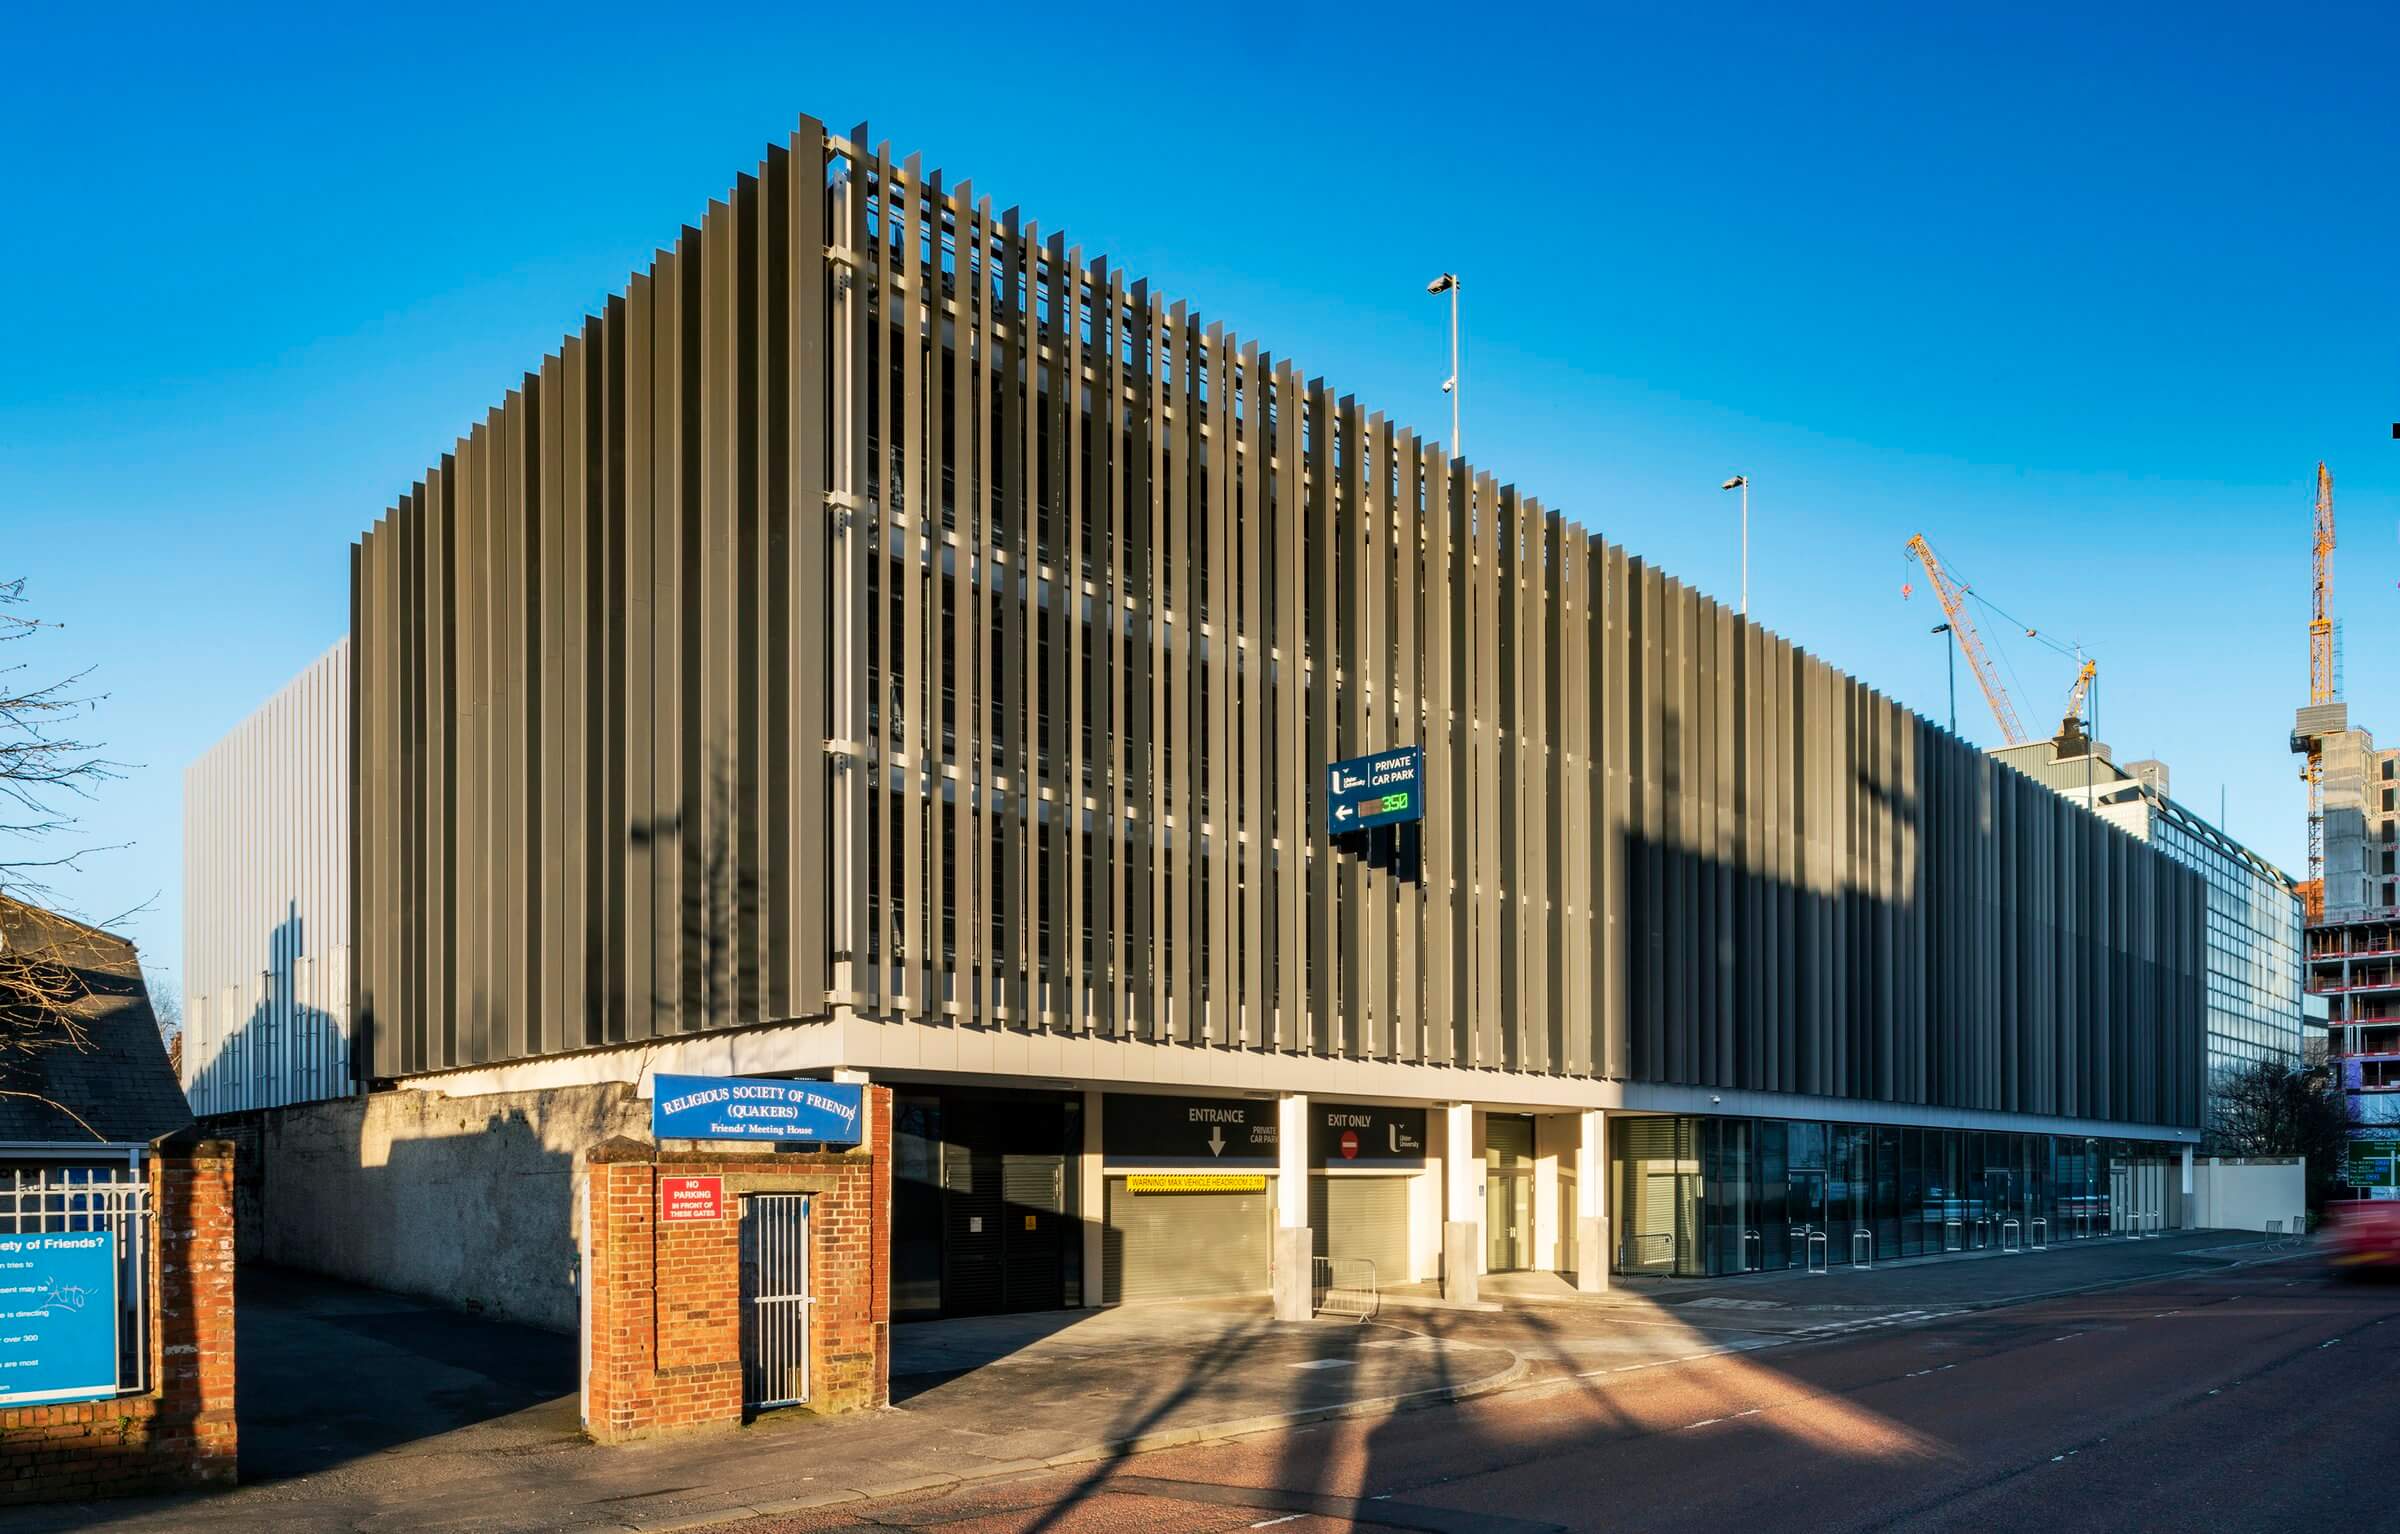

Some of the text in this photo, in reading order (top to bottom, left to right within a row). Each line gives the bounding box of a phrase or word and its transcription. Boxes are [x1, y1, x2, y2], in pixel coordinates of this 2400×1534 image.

[1375, 756, 1411, 773] PRIVATE
[1372, 774, 1390, 786] CAR
[1391, 769, 1415, 782] PARK
[1382, 792, 1408, 813] 350
[661, 1086, 856, 1121] RELIGIOUS SOCIETY OF FRIENDS
[727, 1103, 799, 1119] (QUAKERS)
[1189, 1108, 1245, 1123] ENTRANCE
[1328, 1114, 1372, 1127] EXIT ONLY
[711, 1123, 813, 1135] Friends' Meeting House
[1252, 1126, 1277, 1135] PRIVATE
[1250, 1135, 1263, 1144] CAR
[686, 1181, 699, 1189] NO
[674, 1191, 711, 1199] PARKING
[26, 1240, 41, 1250] of
[44, 1237, 105, 1249] Friends?
[23, 1334, 39, 1342] 300
